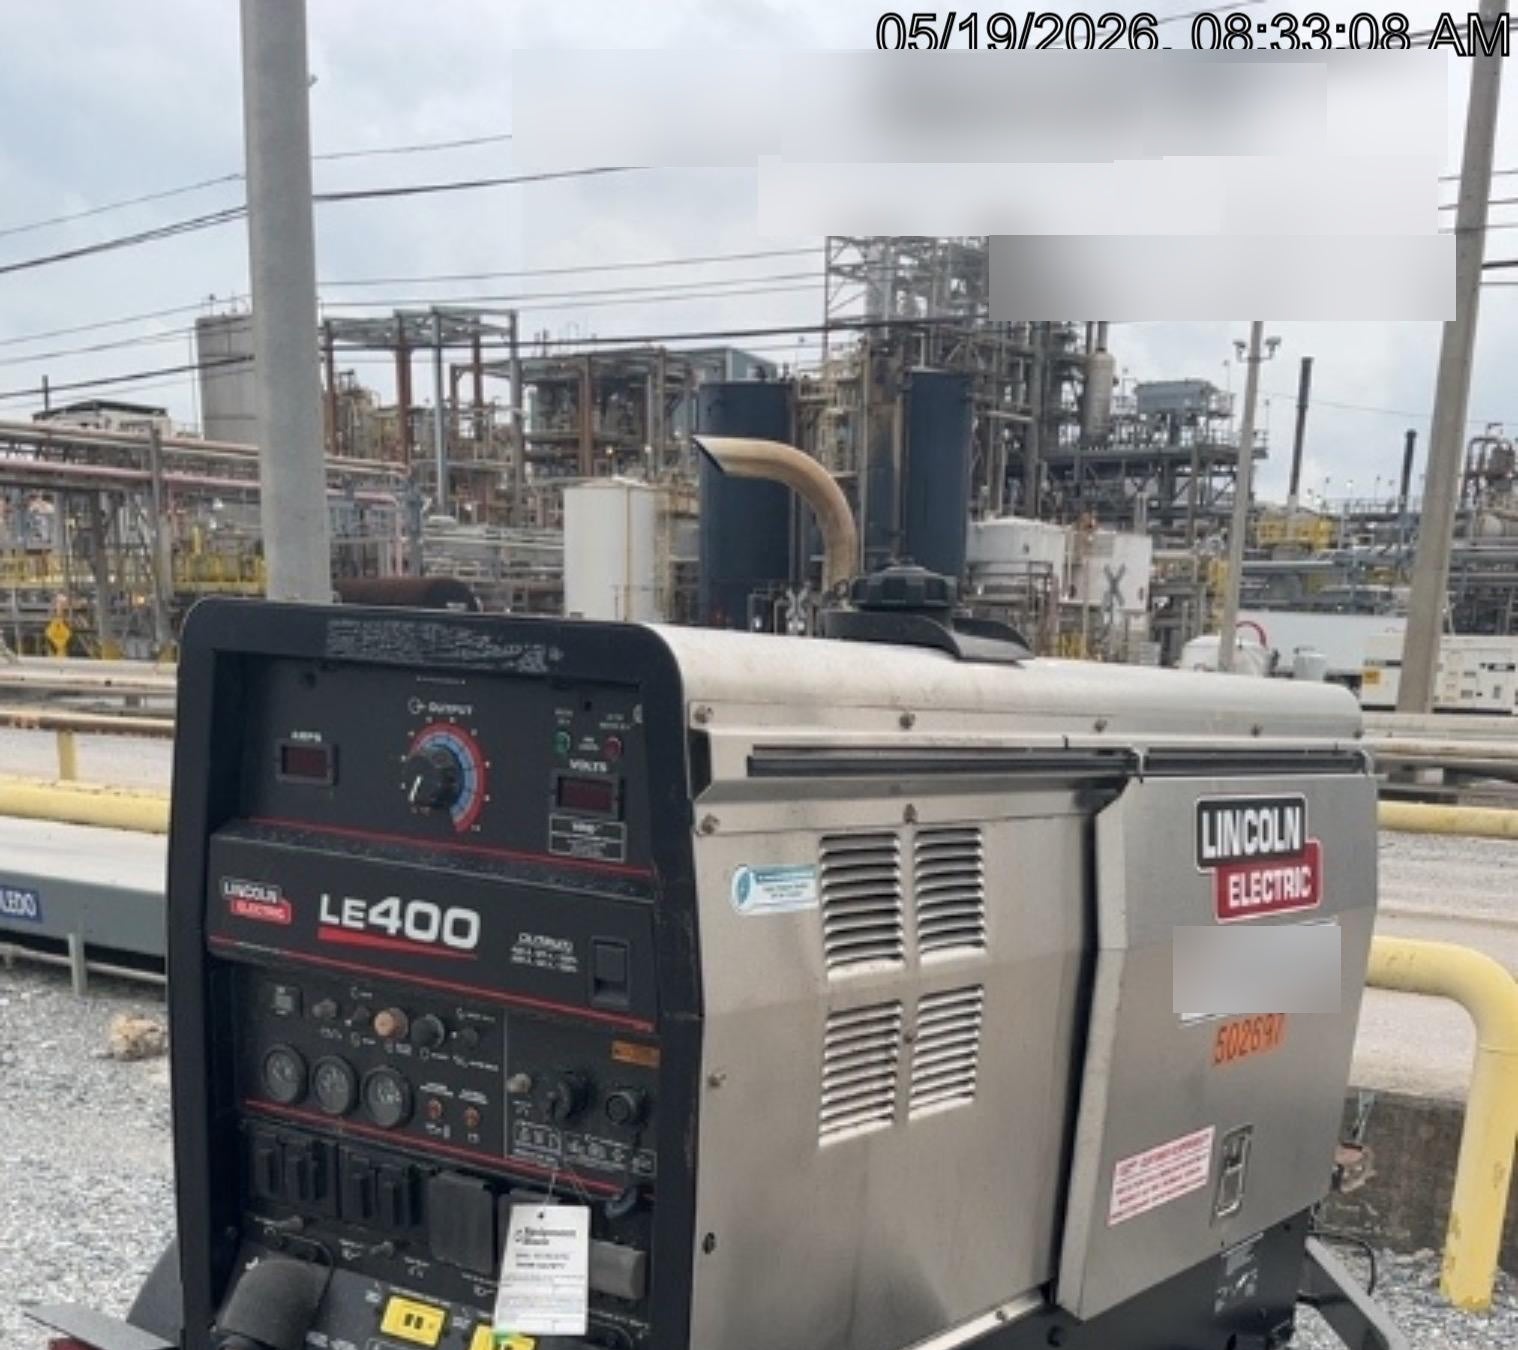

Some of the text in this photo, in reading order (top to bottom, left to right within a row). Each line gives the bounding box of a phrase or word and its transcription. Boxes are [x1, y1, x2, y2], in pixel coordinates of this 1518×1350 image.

[1202, 806, 1300, 859] LINCOLN
[224, 881, 277, 903] LINCOLN
[1229, 865, 1312, 909] ELECTRIC
[320, 893, 480, 949] LE400
